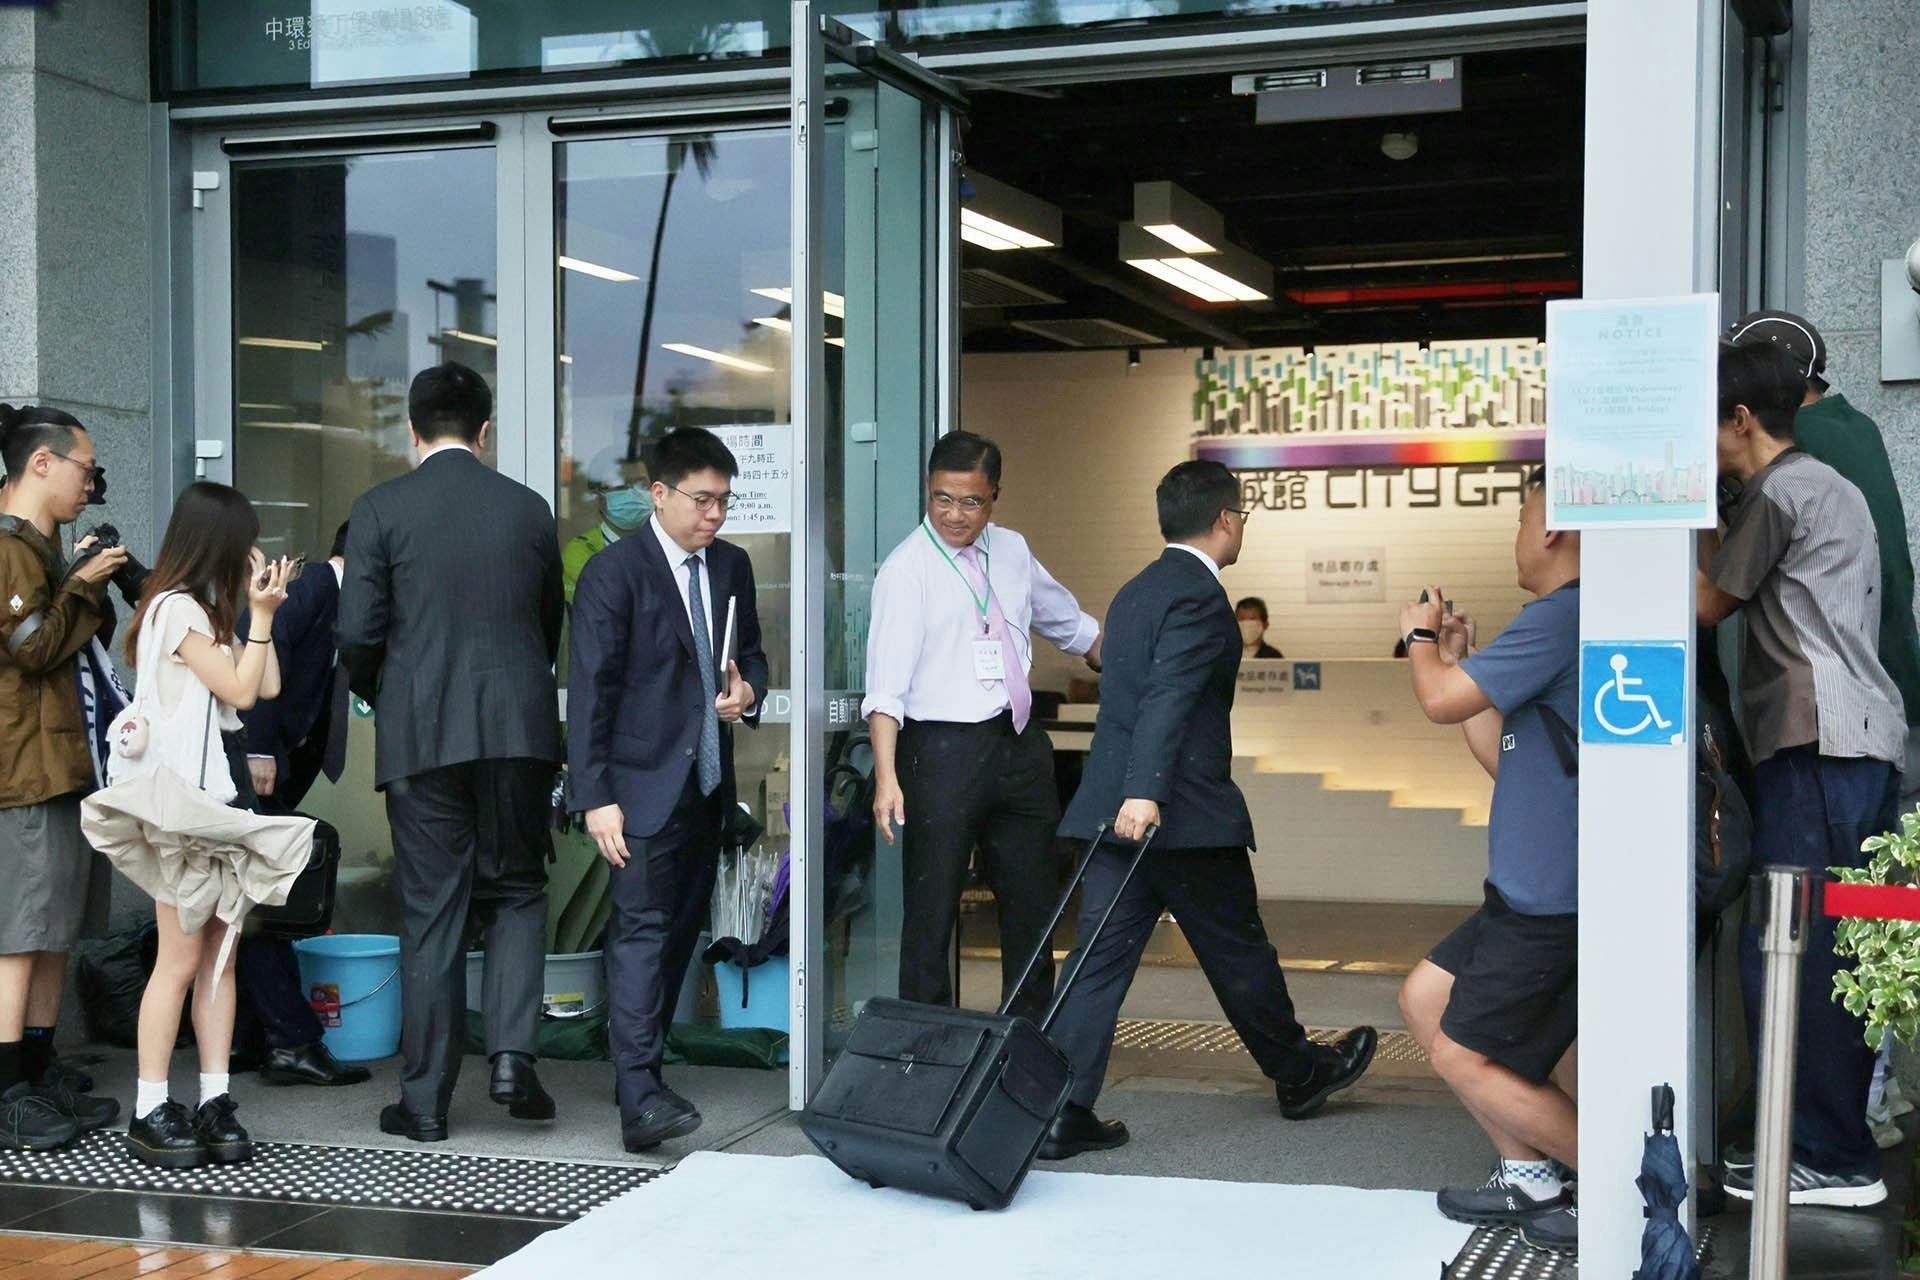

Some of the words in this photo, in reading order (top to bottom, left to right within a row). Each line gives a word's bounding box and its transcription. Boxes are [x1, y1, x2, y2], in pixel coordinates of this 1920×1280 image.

[1598, 327, 1664, 340] NOTICE
[720, 434, 763, 448] 場時間
[1326, 466, 1440, 508] CITY
[1455, 462, 1535, 507] GA
